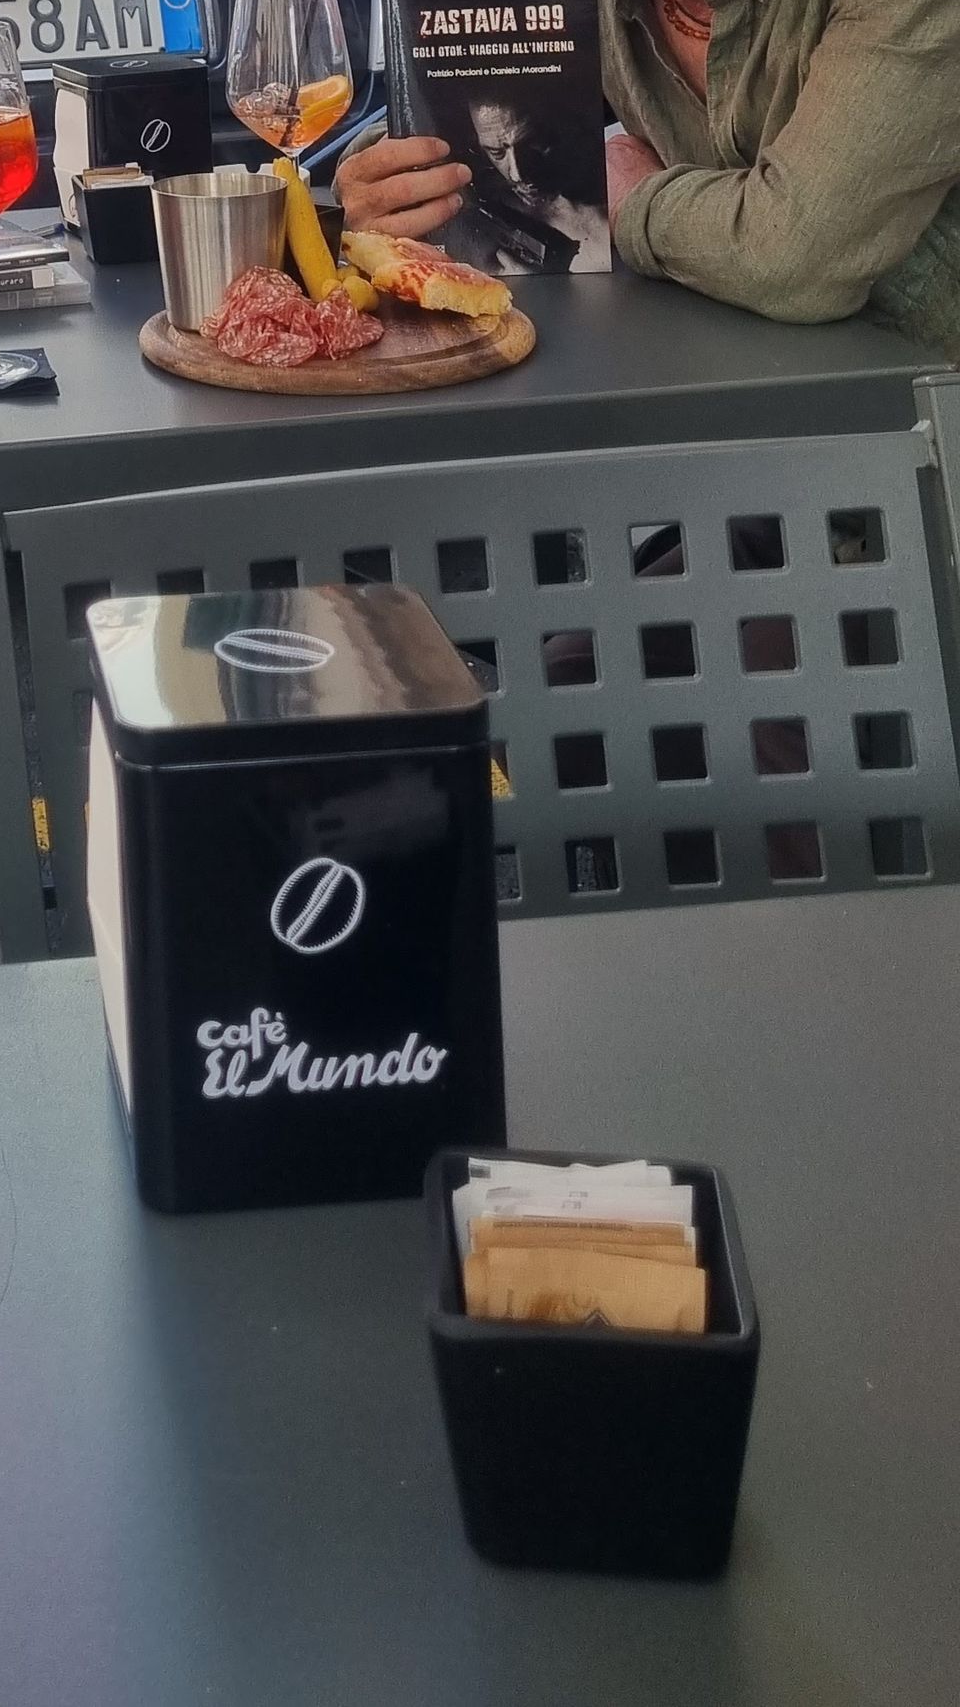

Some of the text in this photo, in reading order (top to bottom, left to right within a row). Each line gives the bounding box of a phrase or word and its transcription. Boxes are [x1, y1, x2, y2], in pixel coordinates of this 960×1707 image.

[420, 4, 565, 36] ZASTAVA 999
[412, 40, 575, 58] GOLI OTOK: VIAGGIO ALL'INFERNO
[427, 68, 454, 78] Patrizio
[455, 67, 483, 77] Pacioni
[490, 66, 520, 76] Daniela
[522, 64, 562, 74] Morandini
[202, 1032, 448, 1099] El Mundo
